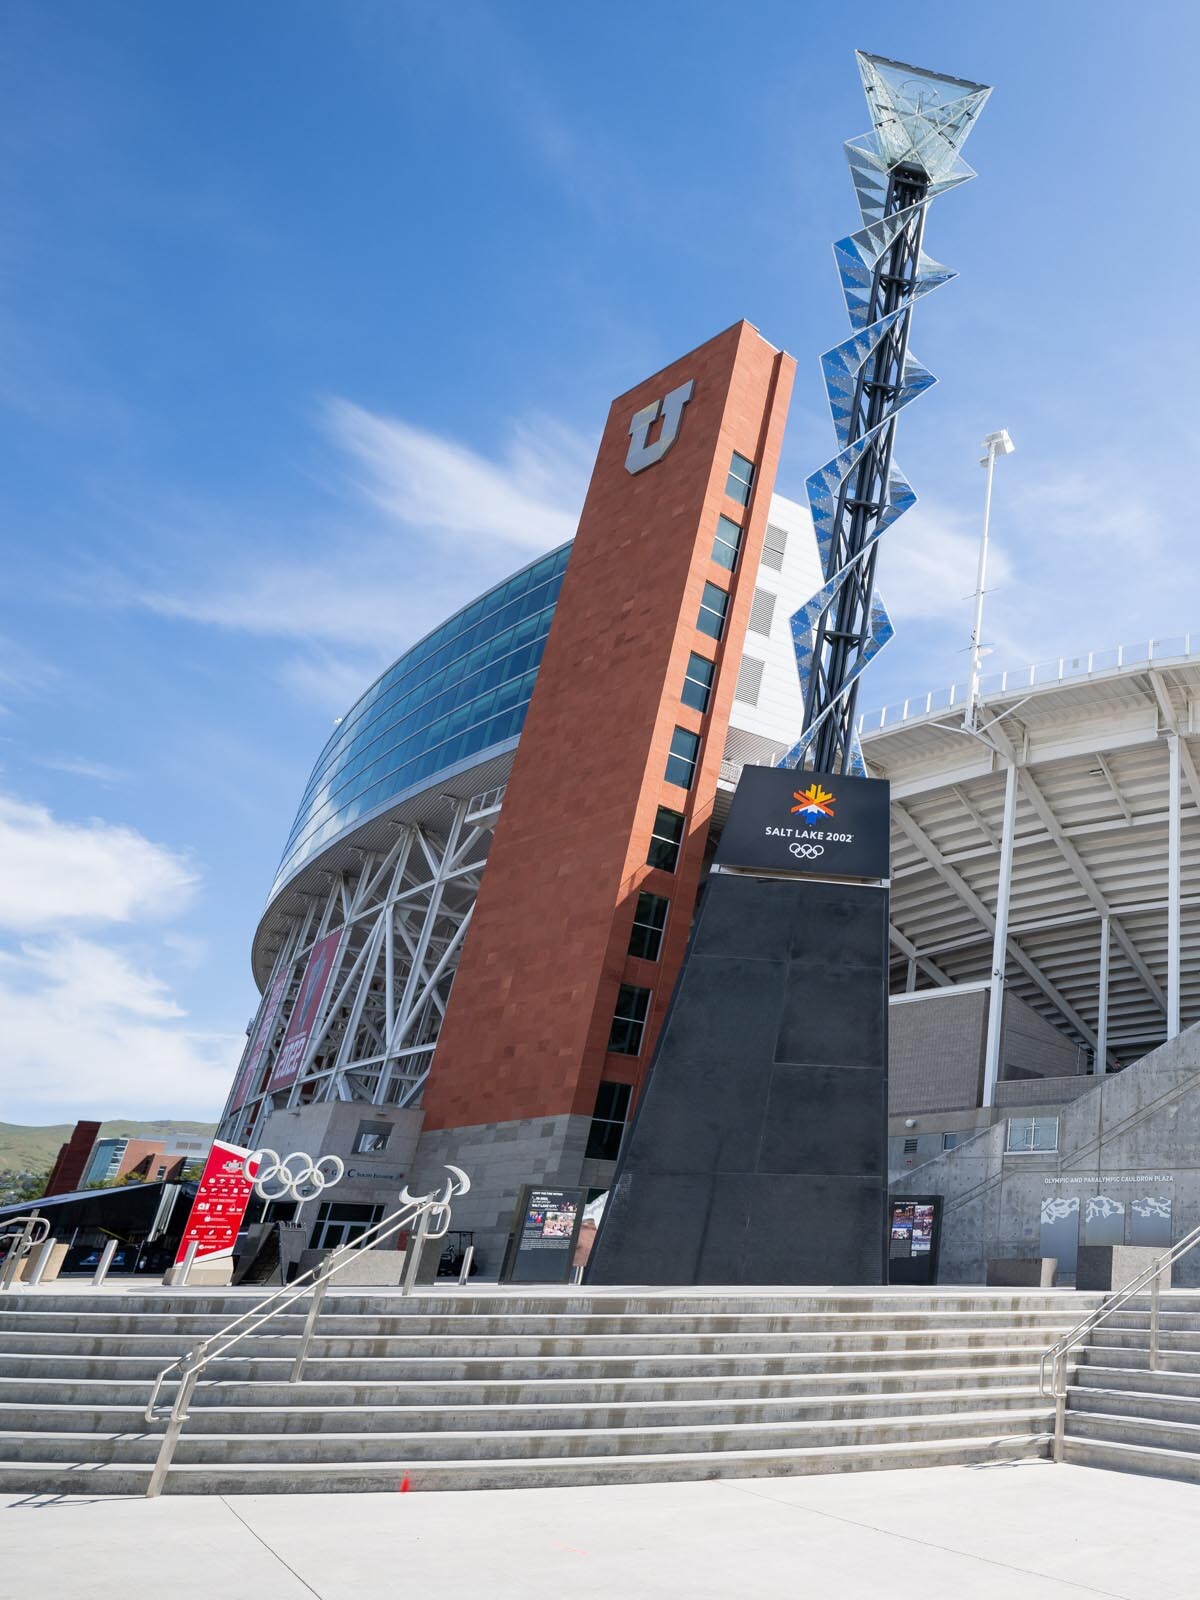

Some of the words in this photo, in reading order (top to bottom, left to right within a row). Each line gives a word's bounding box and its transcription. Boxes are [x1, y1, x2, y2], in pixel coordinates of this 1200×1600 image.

[624, 379, 697, 476] U
[765, 826, 793, 838] SALT
[794, 829, 824, 840] LAKE
[826, 832, 853, 843] 2002
[1120, 1175, 1153, 1183] CAULDRON
